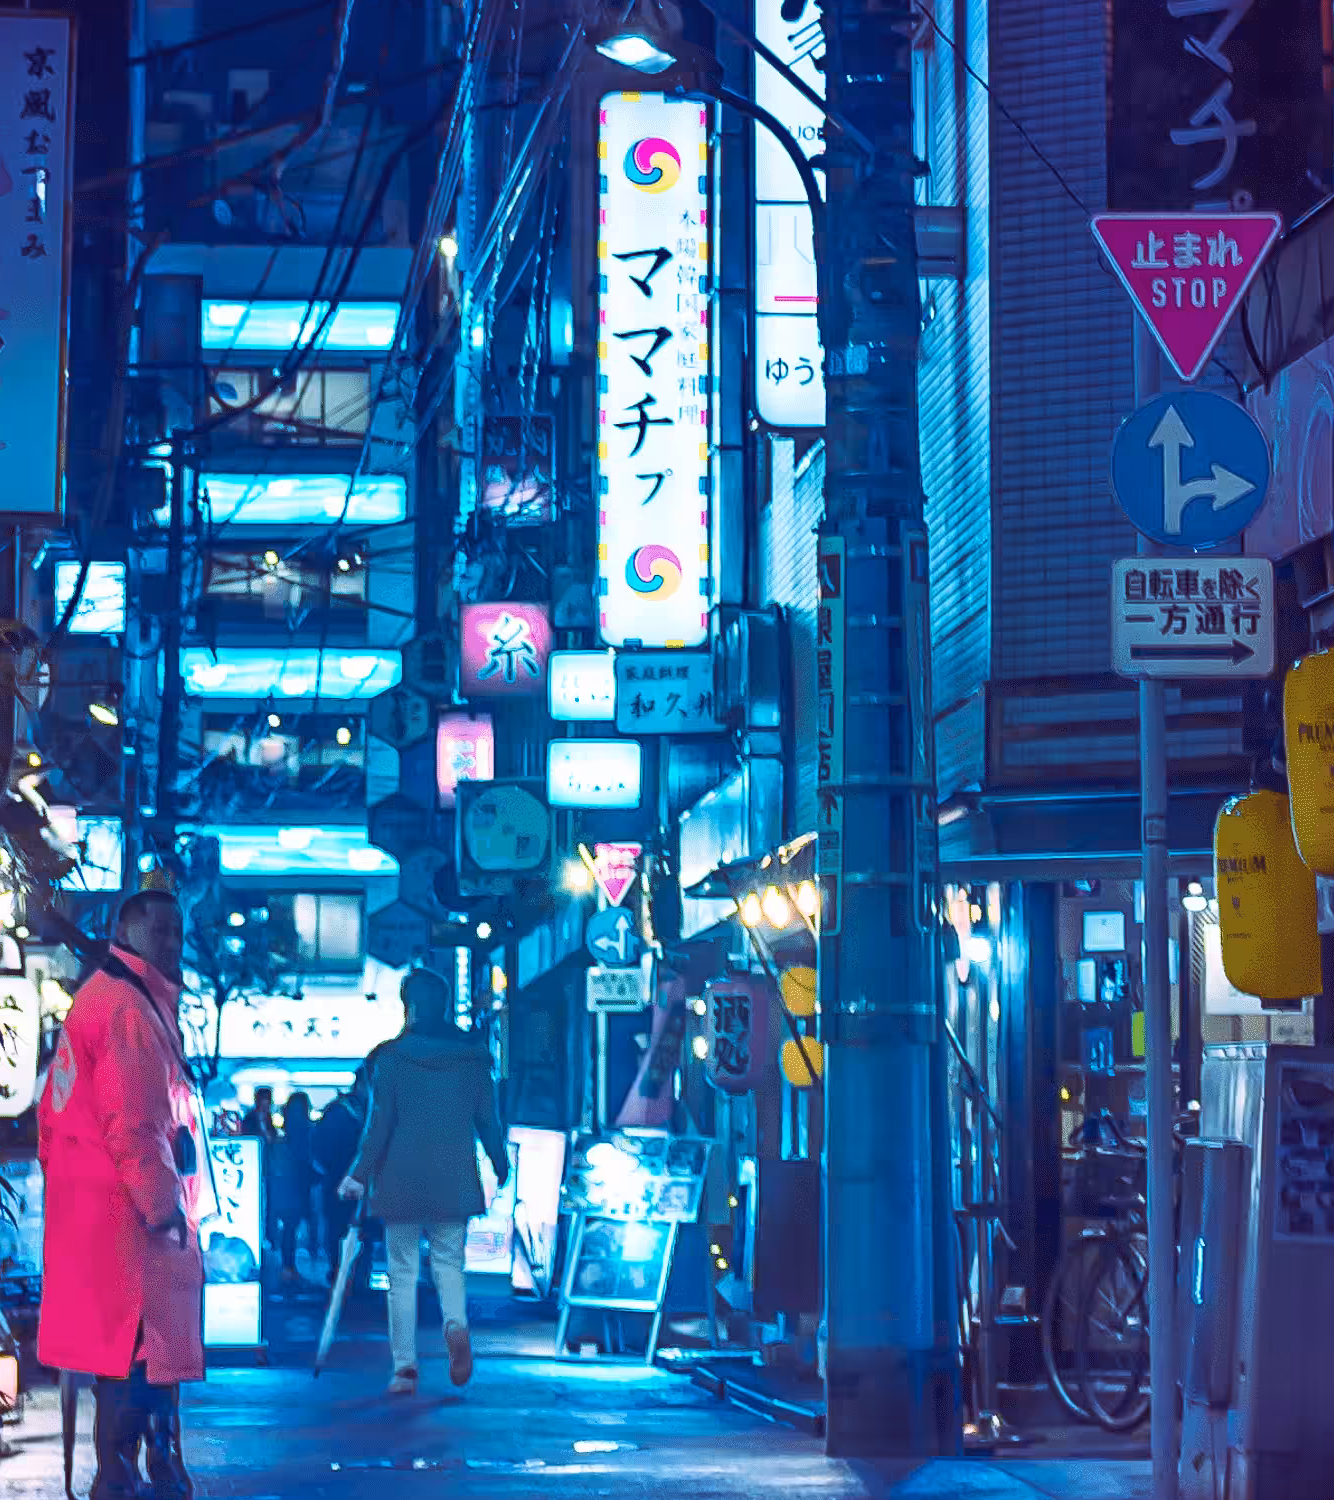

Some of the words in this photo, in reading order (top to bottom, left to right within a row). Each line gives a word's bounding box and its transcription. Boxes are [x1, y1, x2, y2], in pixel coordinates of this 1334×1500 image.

[1131, 229, 1244, 269] 止まれ
[1151, 276, 1229, 309] STOP
[611, 246, 675, 507] ママチプ
[1124, 567, 1261, 601] 自転車を除く
[1124, 603, 1261, 636] 一方通行
